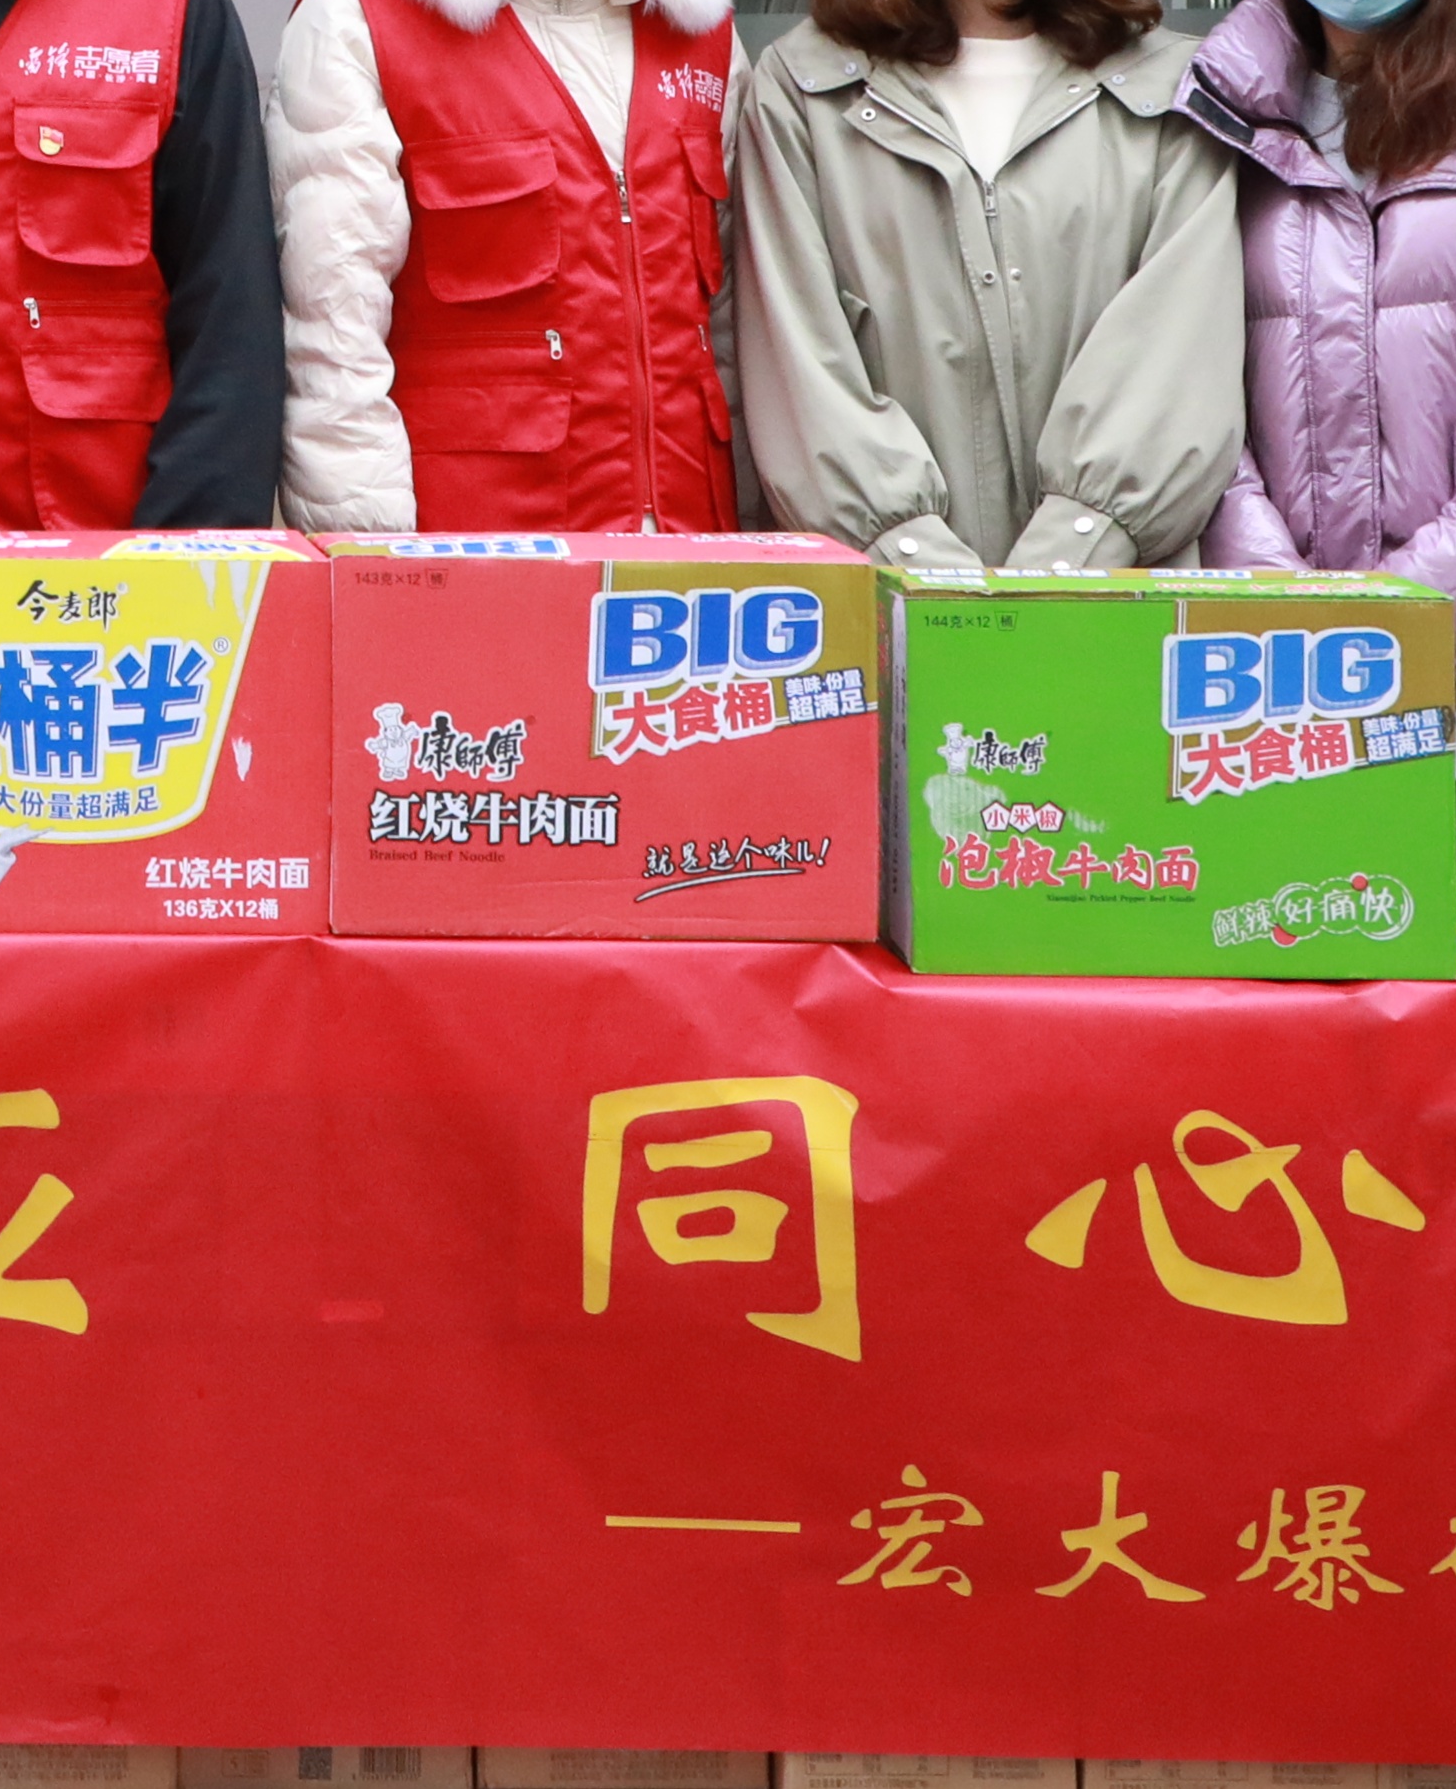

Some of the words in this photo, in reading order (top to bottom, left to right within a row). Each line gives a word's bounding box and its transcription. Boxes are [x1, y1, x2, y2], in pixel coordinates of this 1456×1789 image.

[16, 579, 120, 629] 今麦郎
[595, 593, 821, 684] BIG
[787, 688, 867, 724] 超满足
[1170, 632, 1395, 726] BIG
[611, 682, 774, 757] 大食桶
[1365, 725, 1447, 764] 超满足
[1184, 722, 1350, 799] 大食桶
[369, 791, 620, 845] 红烧牛肉面
[144, 856, 311, 892] 红烧牛肉面
[939, 833, 1198, 890] 泡椒牛肉面
